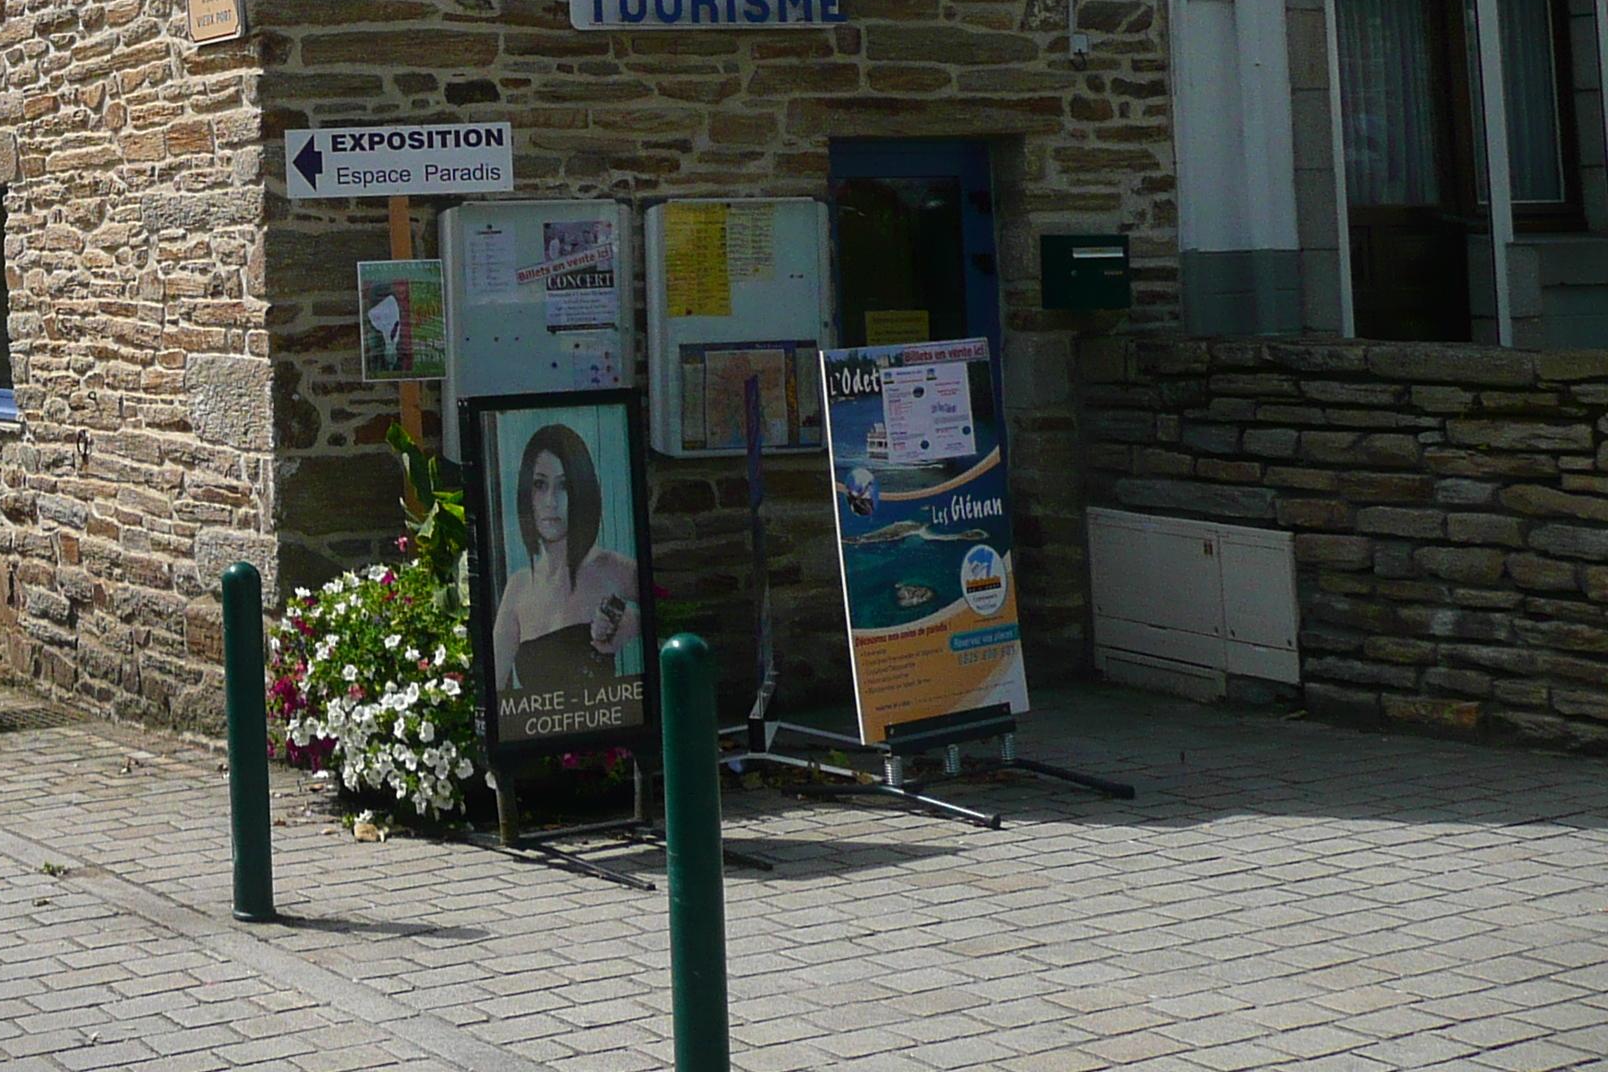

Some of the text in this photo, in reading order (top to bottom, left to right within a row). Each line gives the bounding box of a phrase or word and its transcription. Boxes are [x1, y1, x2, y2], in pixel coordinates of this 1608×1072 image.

[330, 128, 504, 154] EXPOSITION
[336, 162, 502, 188] Espace Paradis
[517, 247, 609, 282] Billets en vente ici
[547, 272, 613, 289] CONCERT
[905, 350, 933, 363] Billets
[935, 351, 946, 360] en
[948, 346, 972, 358] vente
[829, 366, 880, 396] L'Odet
[932, 494, 1003, 526] Les Glénan
[499, 690, 565, 716] MARIE
[584, 681, 644, 707] LAURE
[524, 706, 622, 736] COIFFURE
